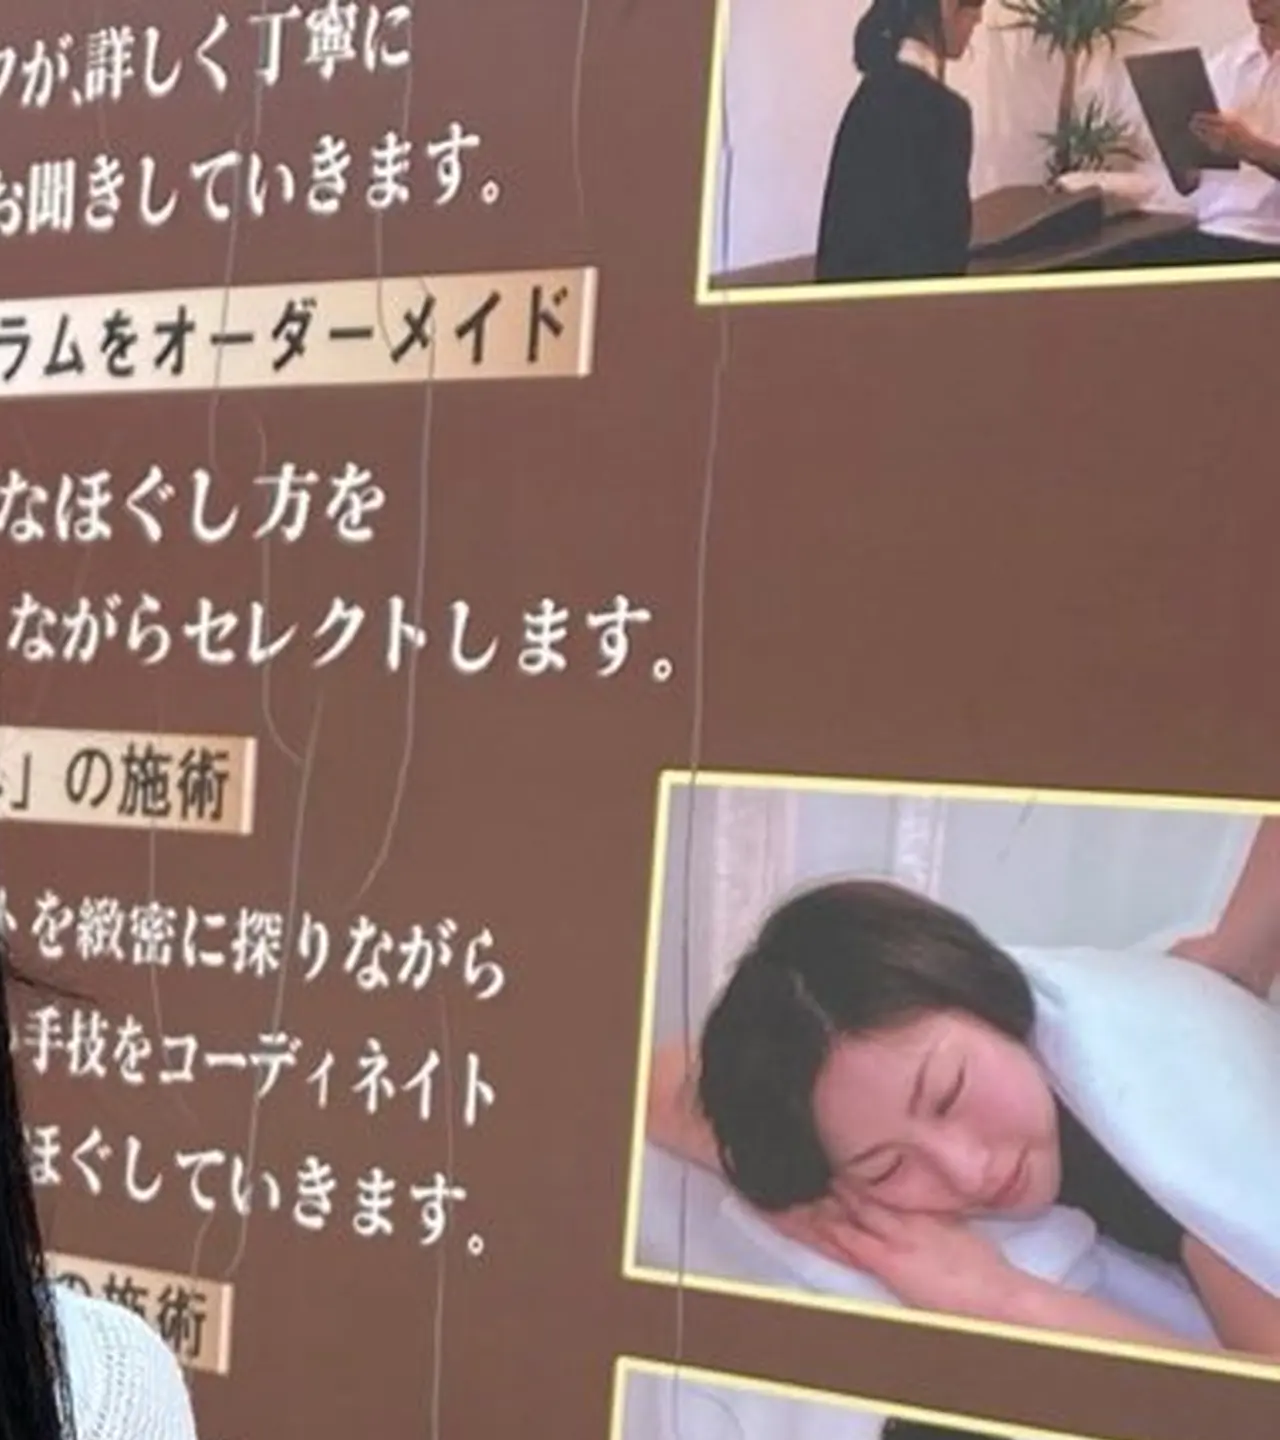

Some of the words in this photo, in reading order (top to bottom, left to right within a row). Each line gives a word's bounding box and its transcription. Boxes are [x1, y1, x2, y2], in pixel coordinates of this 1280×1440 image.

[9, 1003, 496, 1127] 手技をコーディネイト
